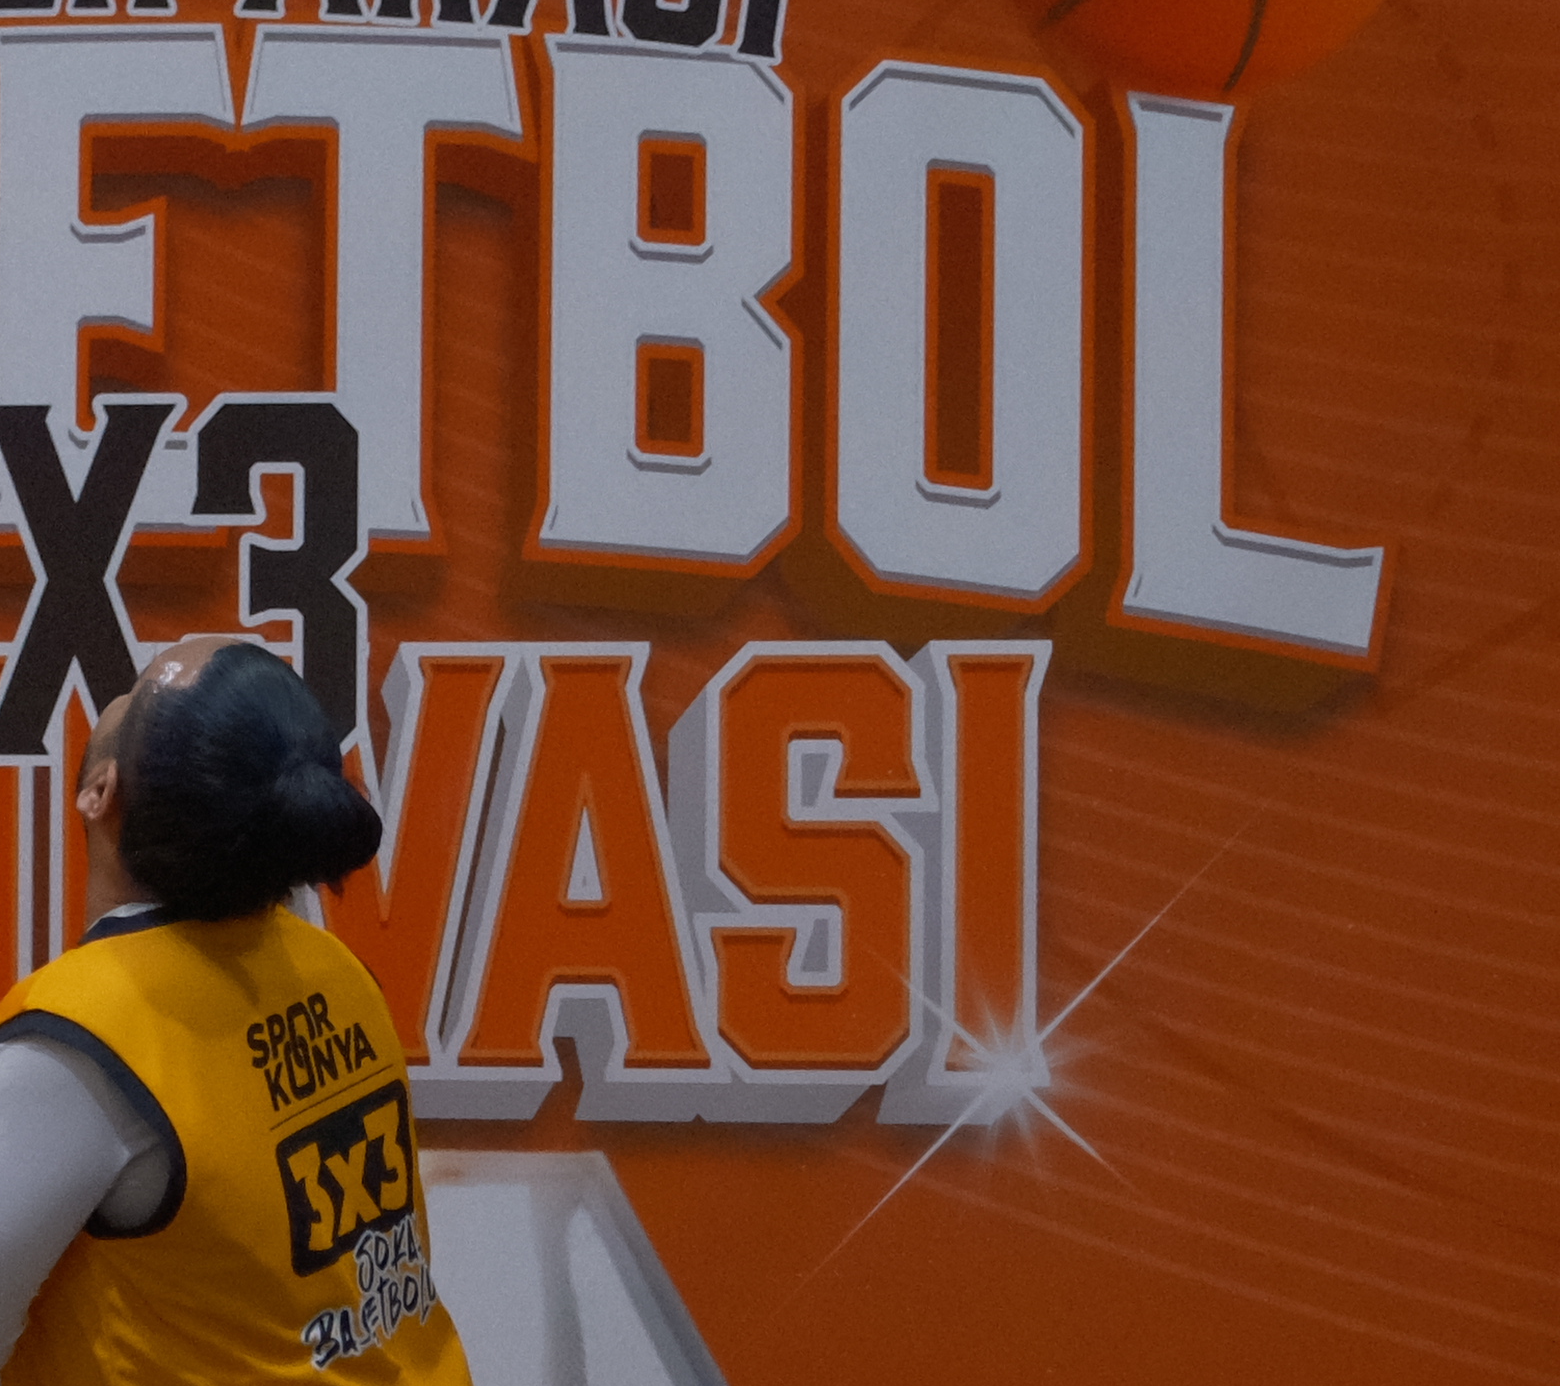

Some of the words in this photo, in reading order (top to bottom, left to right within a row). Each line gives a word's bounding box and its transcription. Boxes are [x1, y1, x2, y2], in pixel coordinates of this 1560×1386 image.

[246, 992, 336, 1070] SPOR
[263, 1022, 378, 1112] KONYA
[354, 1214, 423, 1295] SOKA
